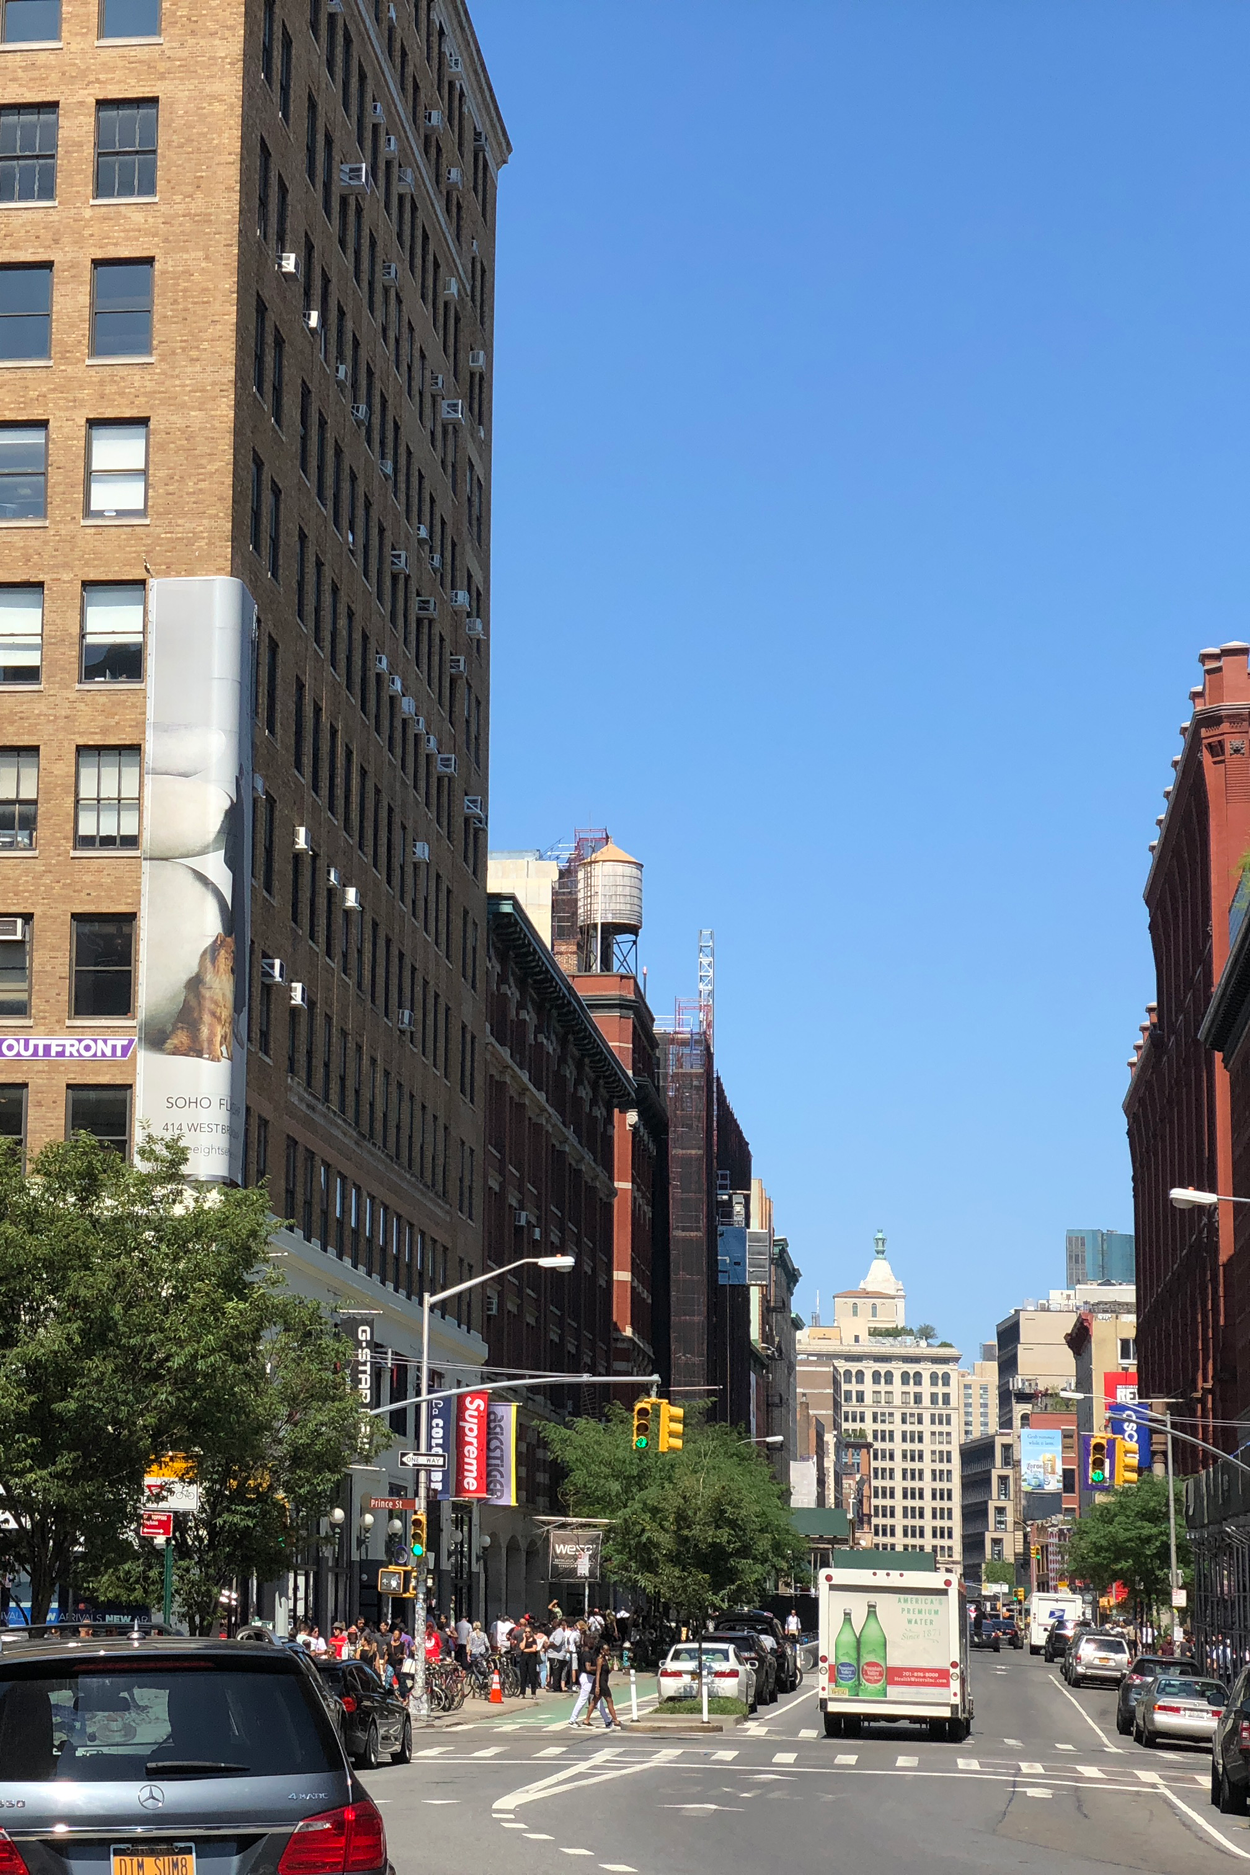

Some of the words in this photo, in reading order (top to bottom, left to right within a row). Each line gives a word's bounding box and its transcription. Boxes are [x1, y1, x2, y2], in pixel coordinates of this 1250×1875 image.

[1, 1038, 129, 1057] OUTFRONT
[166, 1096, 212, 1110] SOHO
[162, 1122, 183, 1133] 414
[187, 1122, 221, 1134] WEST
[432, 1399, 444, 1416] La
[459, 1396, 485, 1491] Supreme
[430, 1418, 444, 1491] COLOBE
[370, 1499, 393, 1509] Prince
[395, 1500, 403, 1509] St
[897, 1597, 943, 1606] AMERICA'S
[901, 1607, 939, 1616] PREMIUM
[105, 1614, 132, 1623] NEW
[907, 1617, 934, 1626] WATER
[119, 1858, 145, 1875] DIM
[154, 1857, 188, 1875] SUM8
